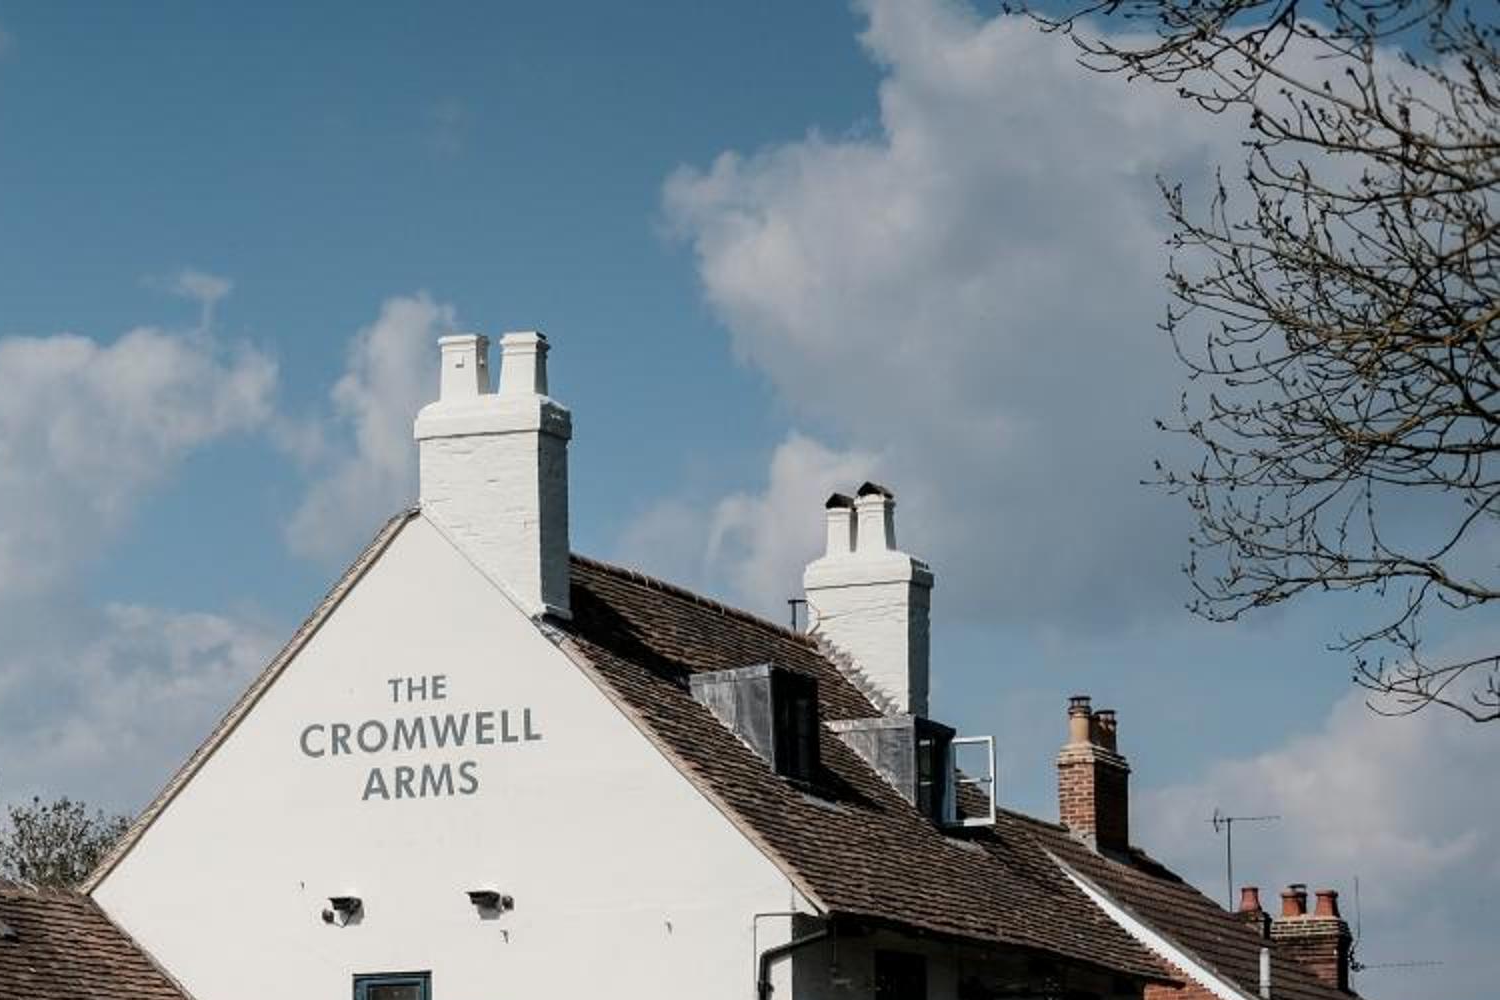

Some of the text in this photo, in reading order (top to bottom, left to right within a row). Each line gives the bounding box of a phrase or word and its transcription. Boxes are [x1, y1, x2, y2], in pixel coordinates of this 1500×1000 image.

[387, 674, 447, 703] THE
[299, 707, 542, 758] CROMWELL
[361, 760, 479, 801] ARMS
